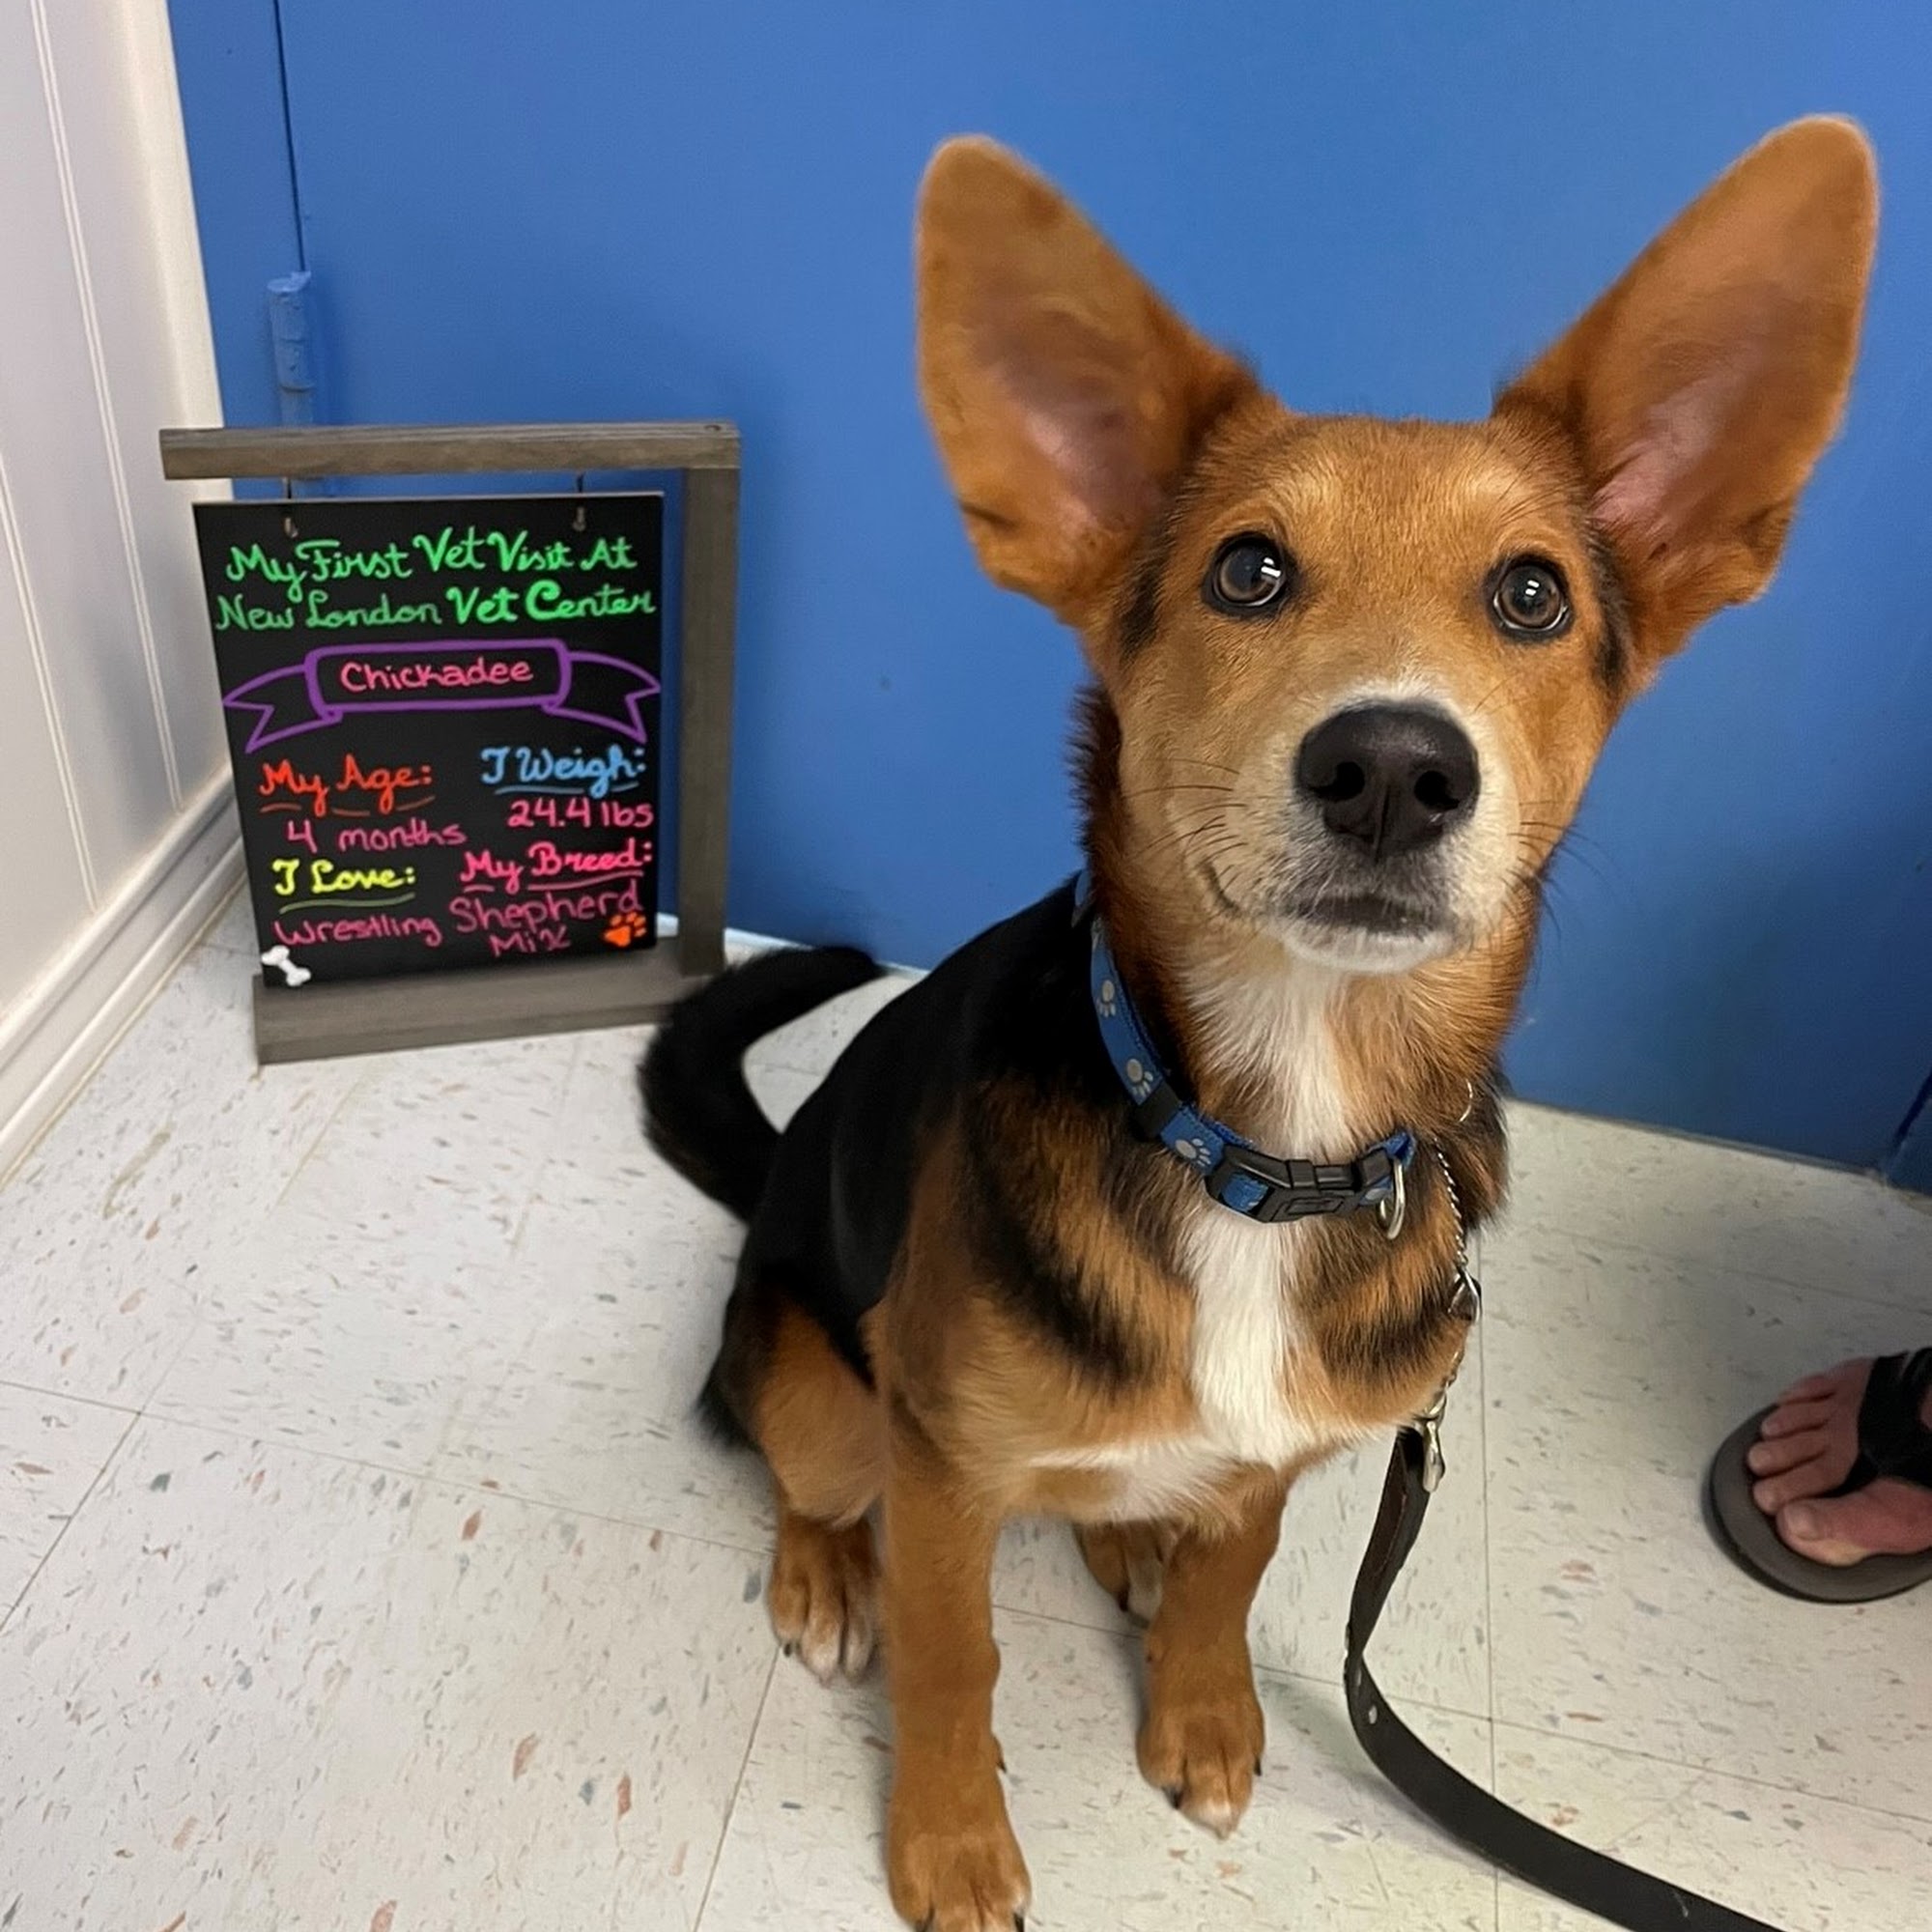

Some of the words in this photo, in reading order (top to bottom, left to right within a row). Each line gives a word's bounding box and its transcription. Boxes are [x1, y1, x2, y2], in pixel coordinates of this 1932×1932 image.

[226, 544, 306, 602] My
[296, 540, 412, 579] First
[413, 526, 486, 570] Vet
[488, 530, 574, 573] Visit
[581, 537, 637, 570] At
[215, 595, 294, 631] New
[305, 590, 441, 629] London
[446, 587, 519, 624] Vet
[526, 580, 656, 620] Center
[339, 657, 534, 692] Chickadee
[259, 759, 327, 817] My
[336, 753, 433, 814] Age:
[516, 744, 646, 798] Weigh:
[287, 820, 318, 853] 4
[338, 818, 468, 852] months
[310, 860, 416, 893] Love:
[460, 851, 524, 894] My
[527, 838, 654, 876] Breed:
[273, 913, 442, 947] Wrestling
[450, 883, 643, 933] Shepherd
